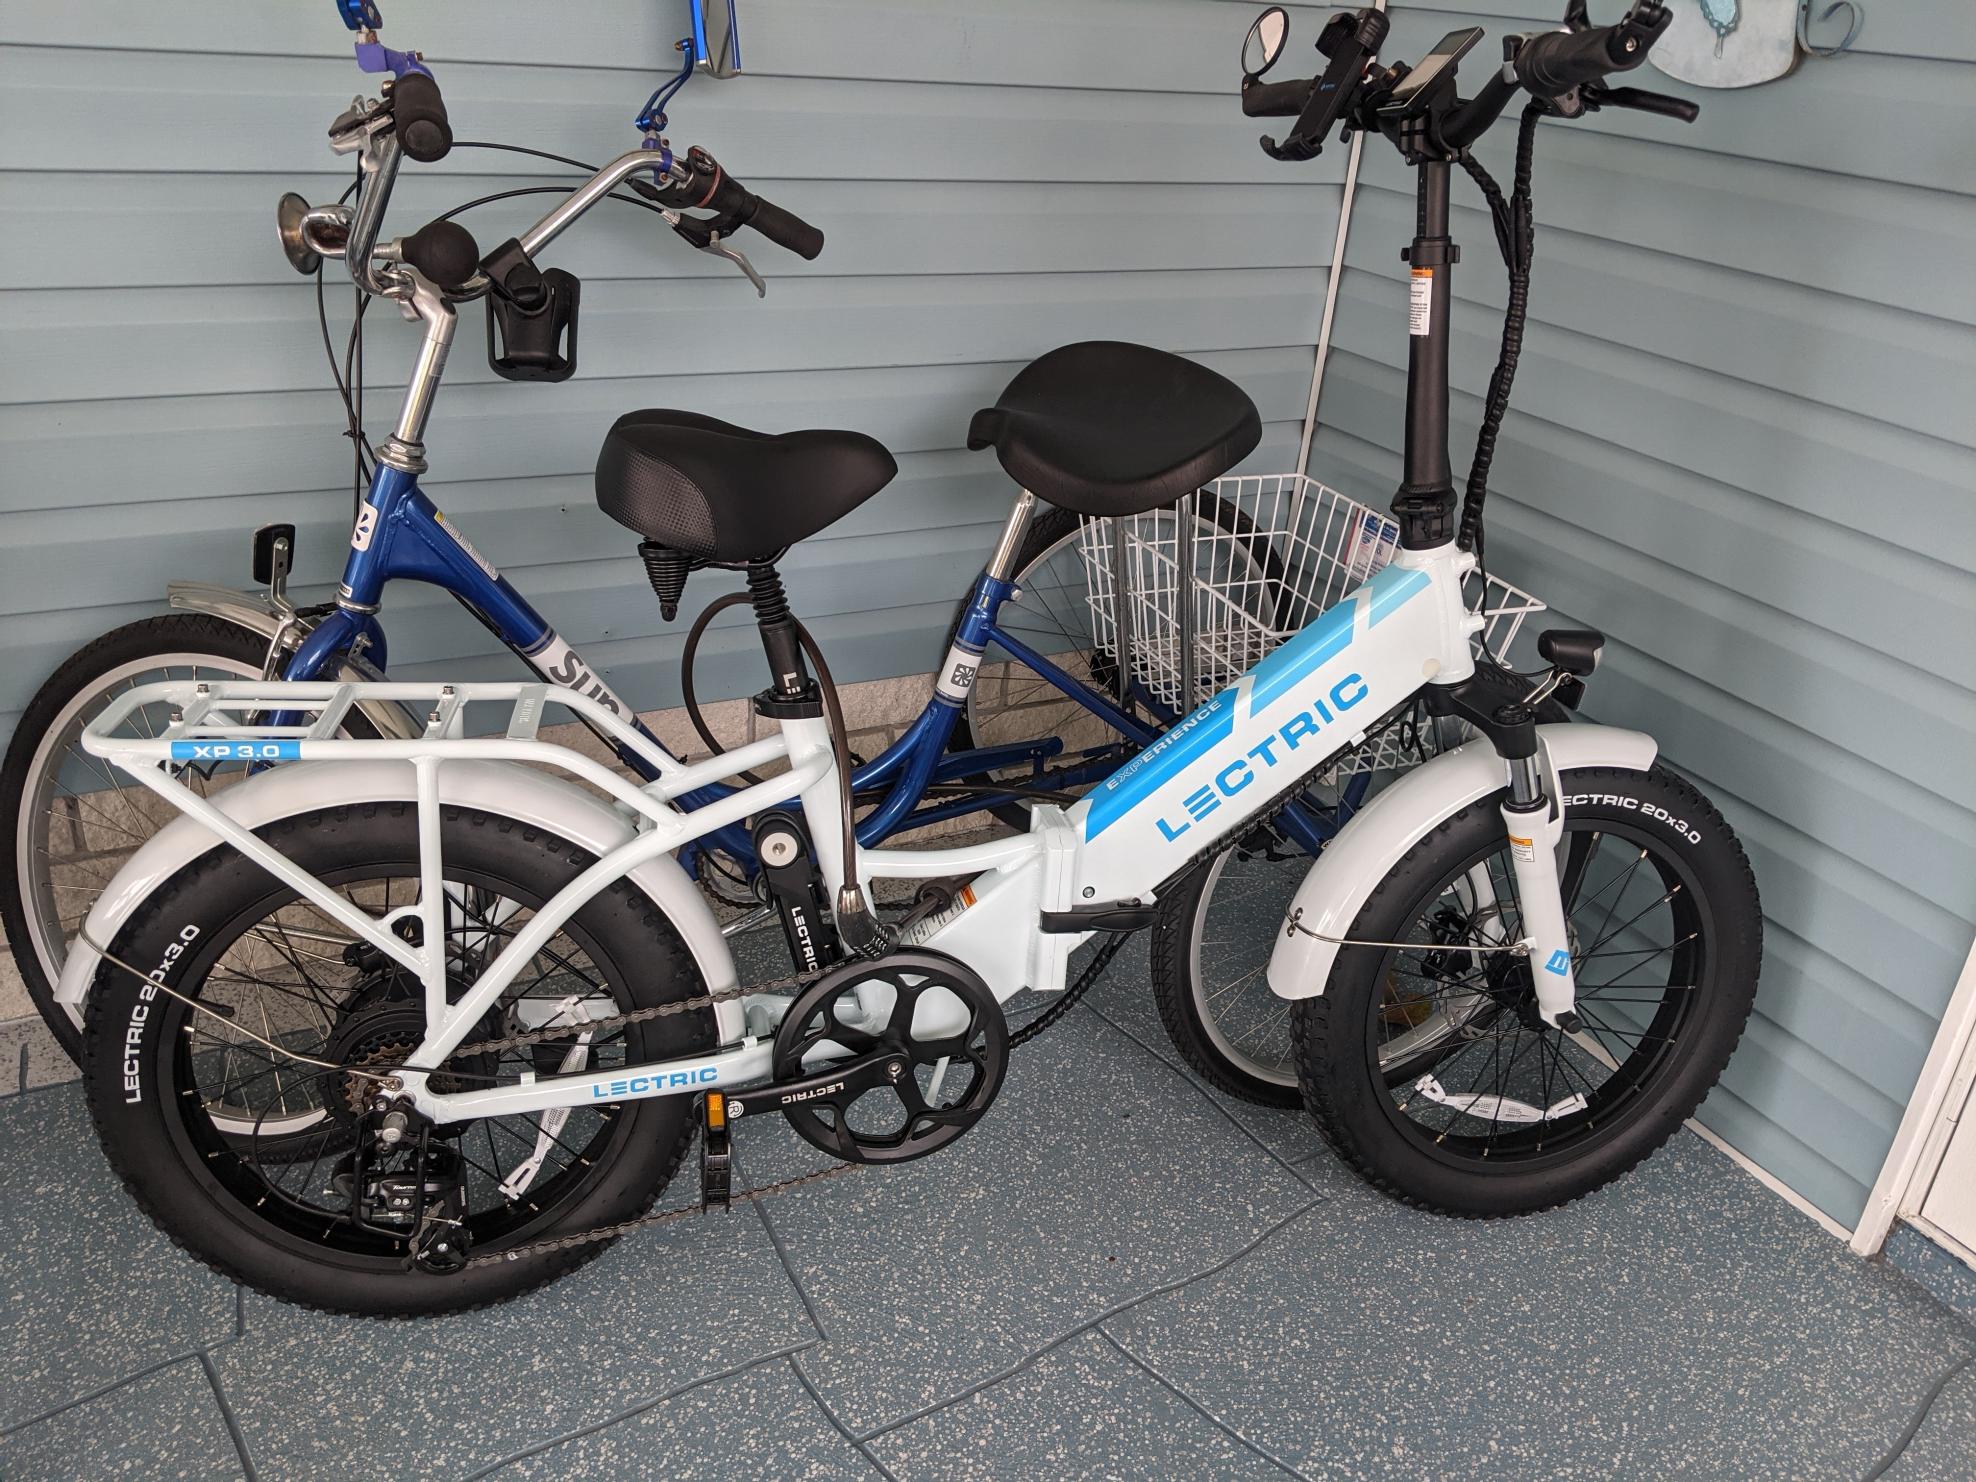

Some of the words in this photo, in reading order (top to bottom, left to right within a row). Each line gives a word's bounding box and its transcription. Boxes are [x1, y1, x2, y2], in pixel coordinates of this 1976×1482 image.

[193, 745, 231, 758] XP
[237, 745, 280, 758] 3.0
[1106, 700, 1222, 791] EXPERIENCE
[1155, 673, 1369, 843] LECTRIC
[1562, 794, 1639, 810] ECTRIC
[1640, 803, 1702, 844] 20x3.0
[791, 906, 819, 973] LECTRIC
[124, 1004, 150, 1104] LECTRIC
[140, 924, 201, 1001] 20x3.0
[593, 1067, 718, 1098] LECTRIC
[781, 1081, 845, 1104] LECTRIC
